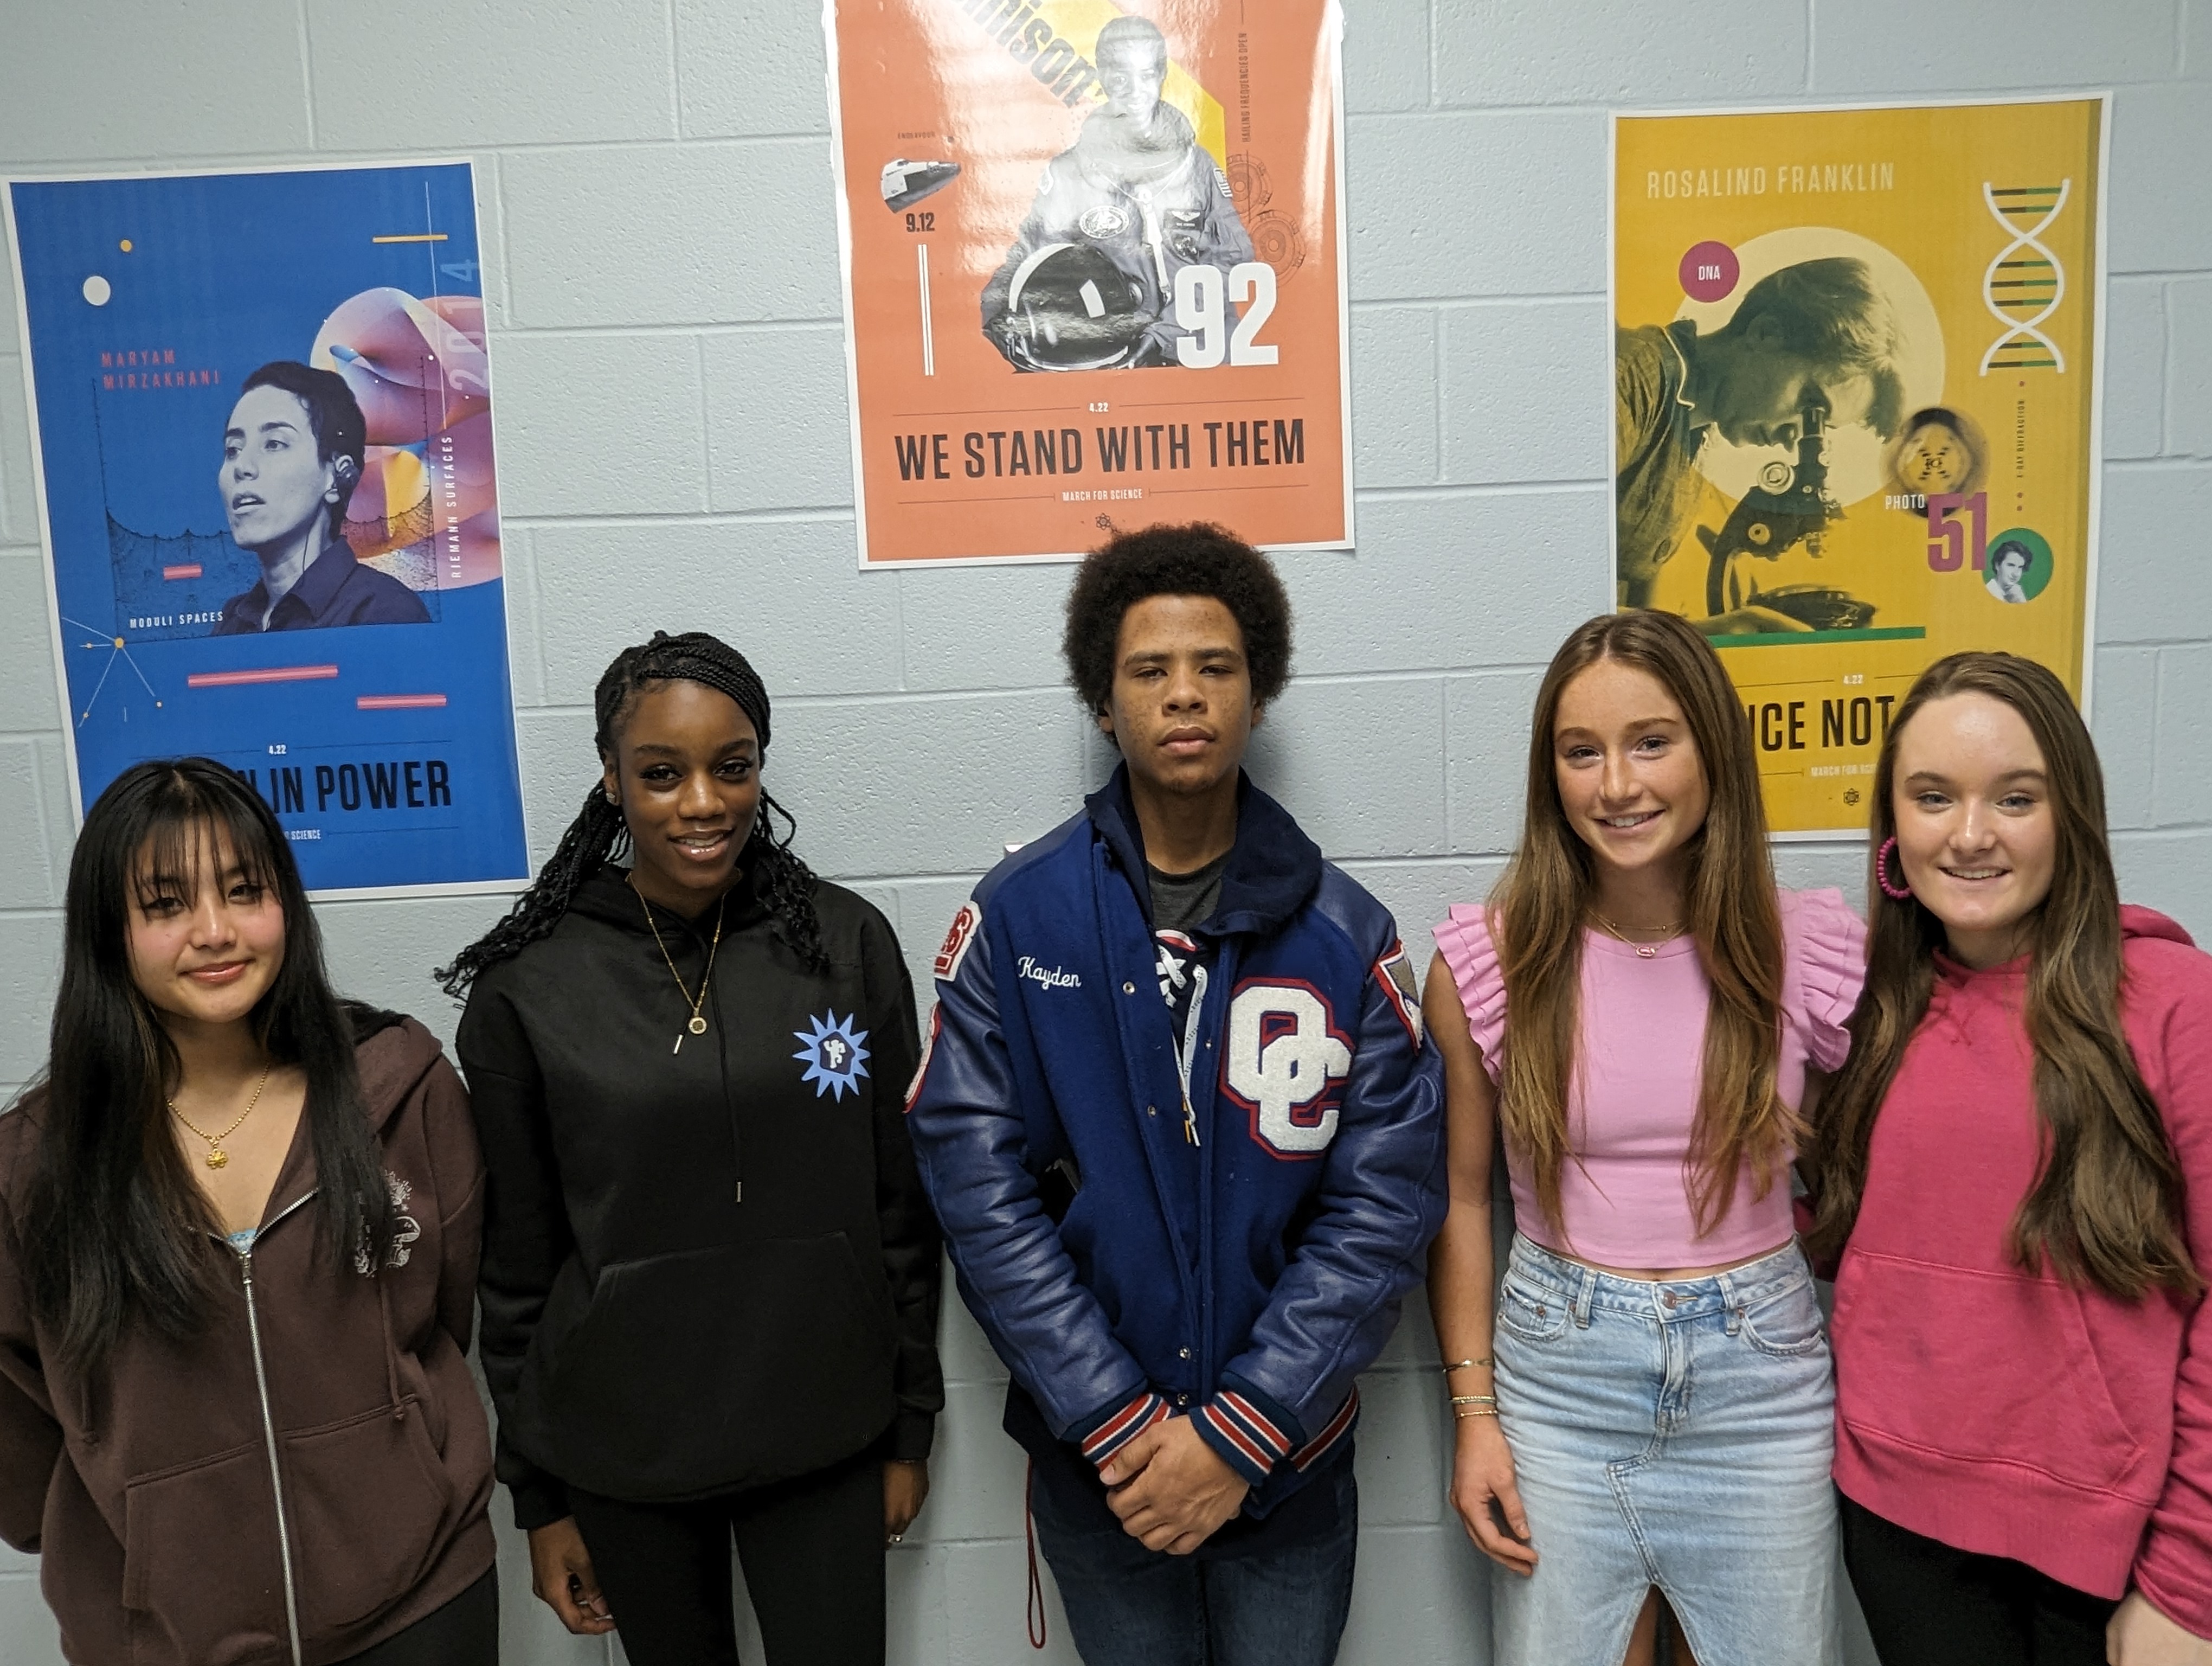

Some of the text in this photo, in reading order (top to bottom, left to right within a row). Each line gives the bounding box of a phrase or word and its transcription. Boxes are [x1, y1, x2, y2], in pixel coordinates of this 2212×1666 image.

[950, 0, 1098, 109] mison
[1238, 33, 1251, 142] HAILING FREQUENCIES OPEN
[1647, 162, 1894, 200] ROSALIND FRANKLIN
[906, 212, 935, 232] 9.12
[1698, 265, 1721, 281] DNA
[1175, 262, 1278, 368] 92
[101, 349, 175, 367] MARYAM
[103, 370, 220, 390] MIRZAKHANI
[1089, 401, 1109, 413] 4.22
[895, 418, 1304, 481] WE STAND WITH THEM
[1062, 488, 1142, 502] MARCH FOR SCIENCE
[1885, 494, 1925, 511] PHOTO
[442, 435, 461, 579] RIEMANN SURFACES
[1927, 492, 1988, 572] 51
[130, 611, 223, 629] MODULI SPACES
[1843, 675, 1863, 684] 4.22
[1822, 695, 1895, 748] NOT
[268, 745, 287, 755] 4.22
[270, 767, 305, 813] IN
[315, 760, 451, 812] POWER
[291, 829, 321, 841] SCIENCE
[1018, 956, 1082, 990] Kayden
